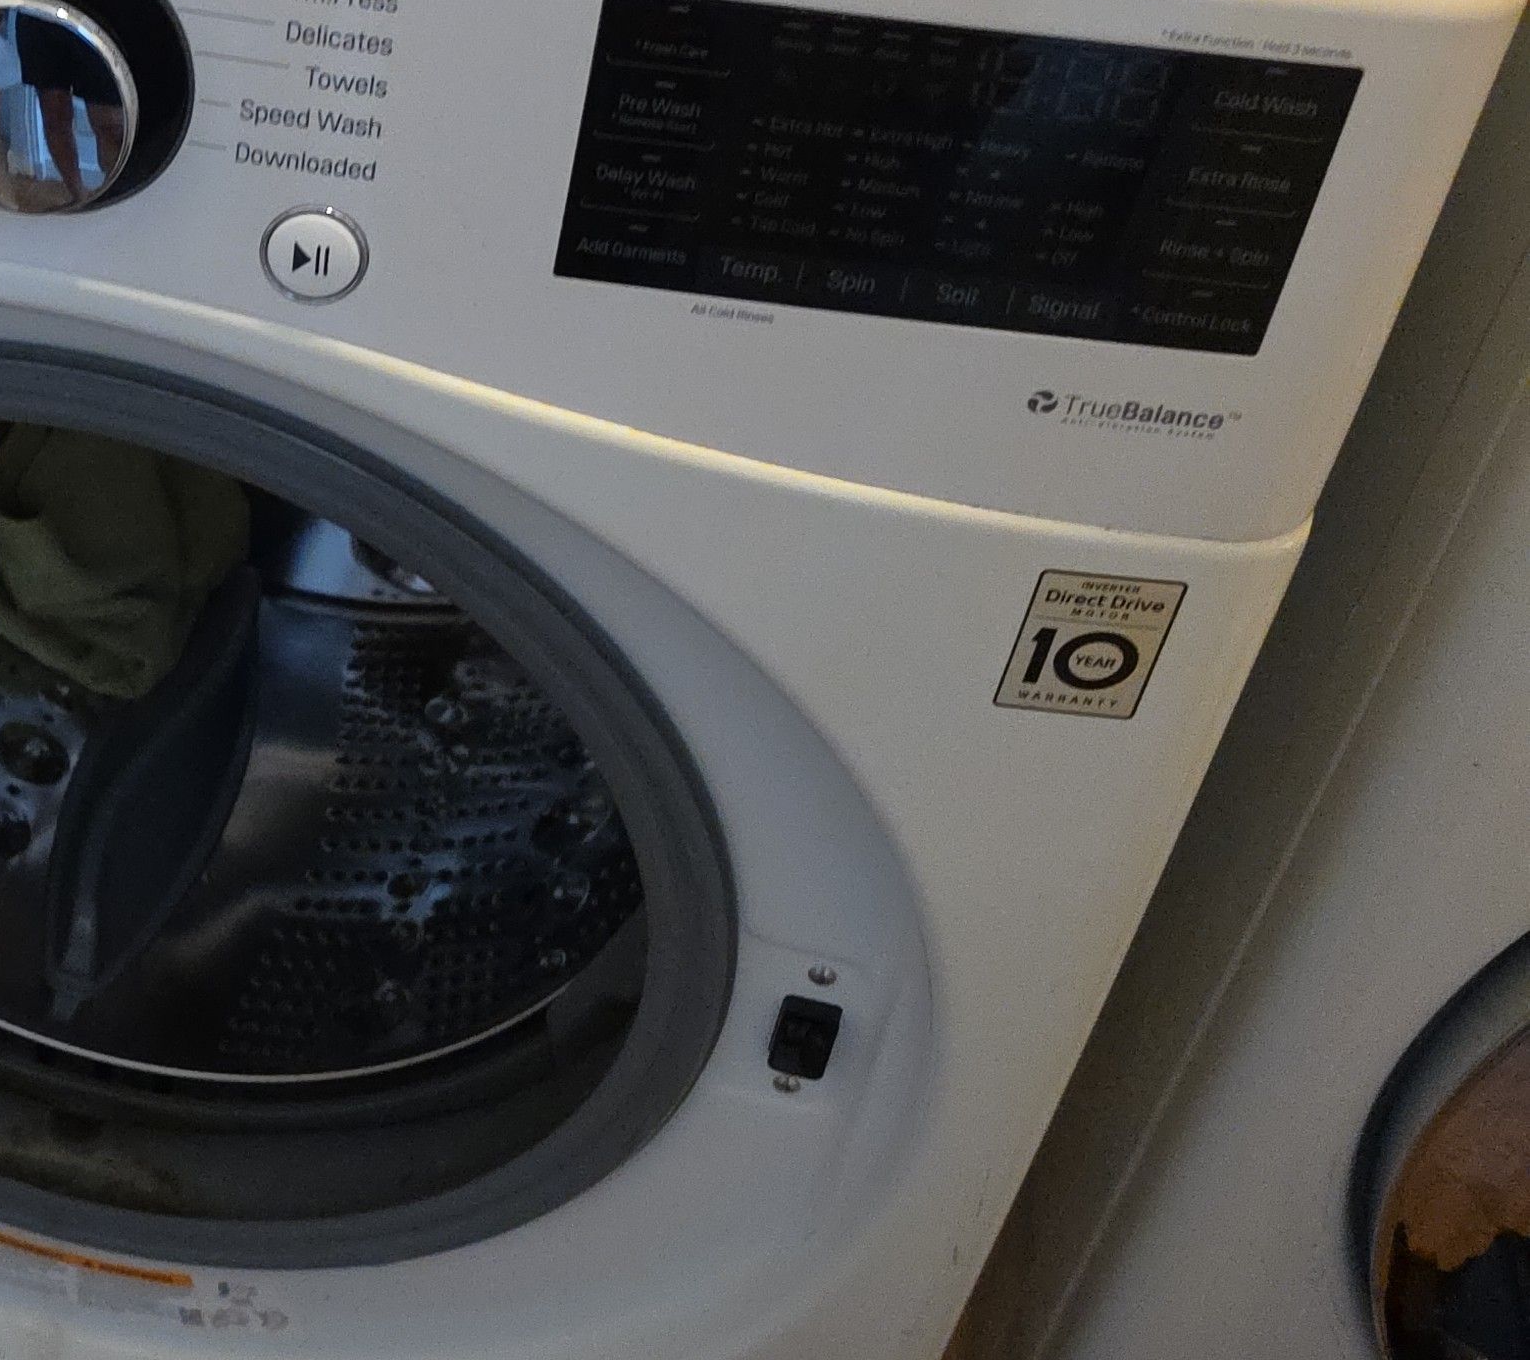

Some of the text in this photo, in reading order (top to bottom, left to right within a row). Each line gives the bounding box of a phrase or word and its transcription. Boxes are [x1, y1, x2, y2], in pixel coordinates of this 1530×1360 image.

[285, 20, 394, 57] Delicates
[306, 64, 388, 100] Towels
[240, 98, 382, 140] Speed Wash
[618, 92, 702, 120] Pre Wash
[235, 141, 377, 182] Downloaded
[596, 162, 645, 185] Delay
[576, 237, 687, 266] Add Garments
[720, 255, 782, 284] Temp.
[828, 269, 876, 296] Spin
[936, 283, 981, 307] Soil
[1027, 293, 1102, 321] Signal
[1045, 589, 1166, 614] Direct Drive
[1071, 607, 1130, 621] MOTOR
[1021, 627, 1140, 692] 10
[1075, 654, 1118, 670] YEAR
[1018, 689, 1119, 708] WARRANTY
